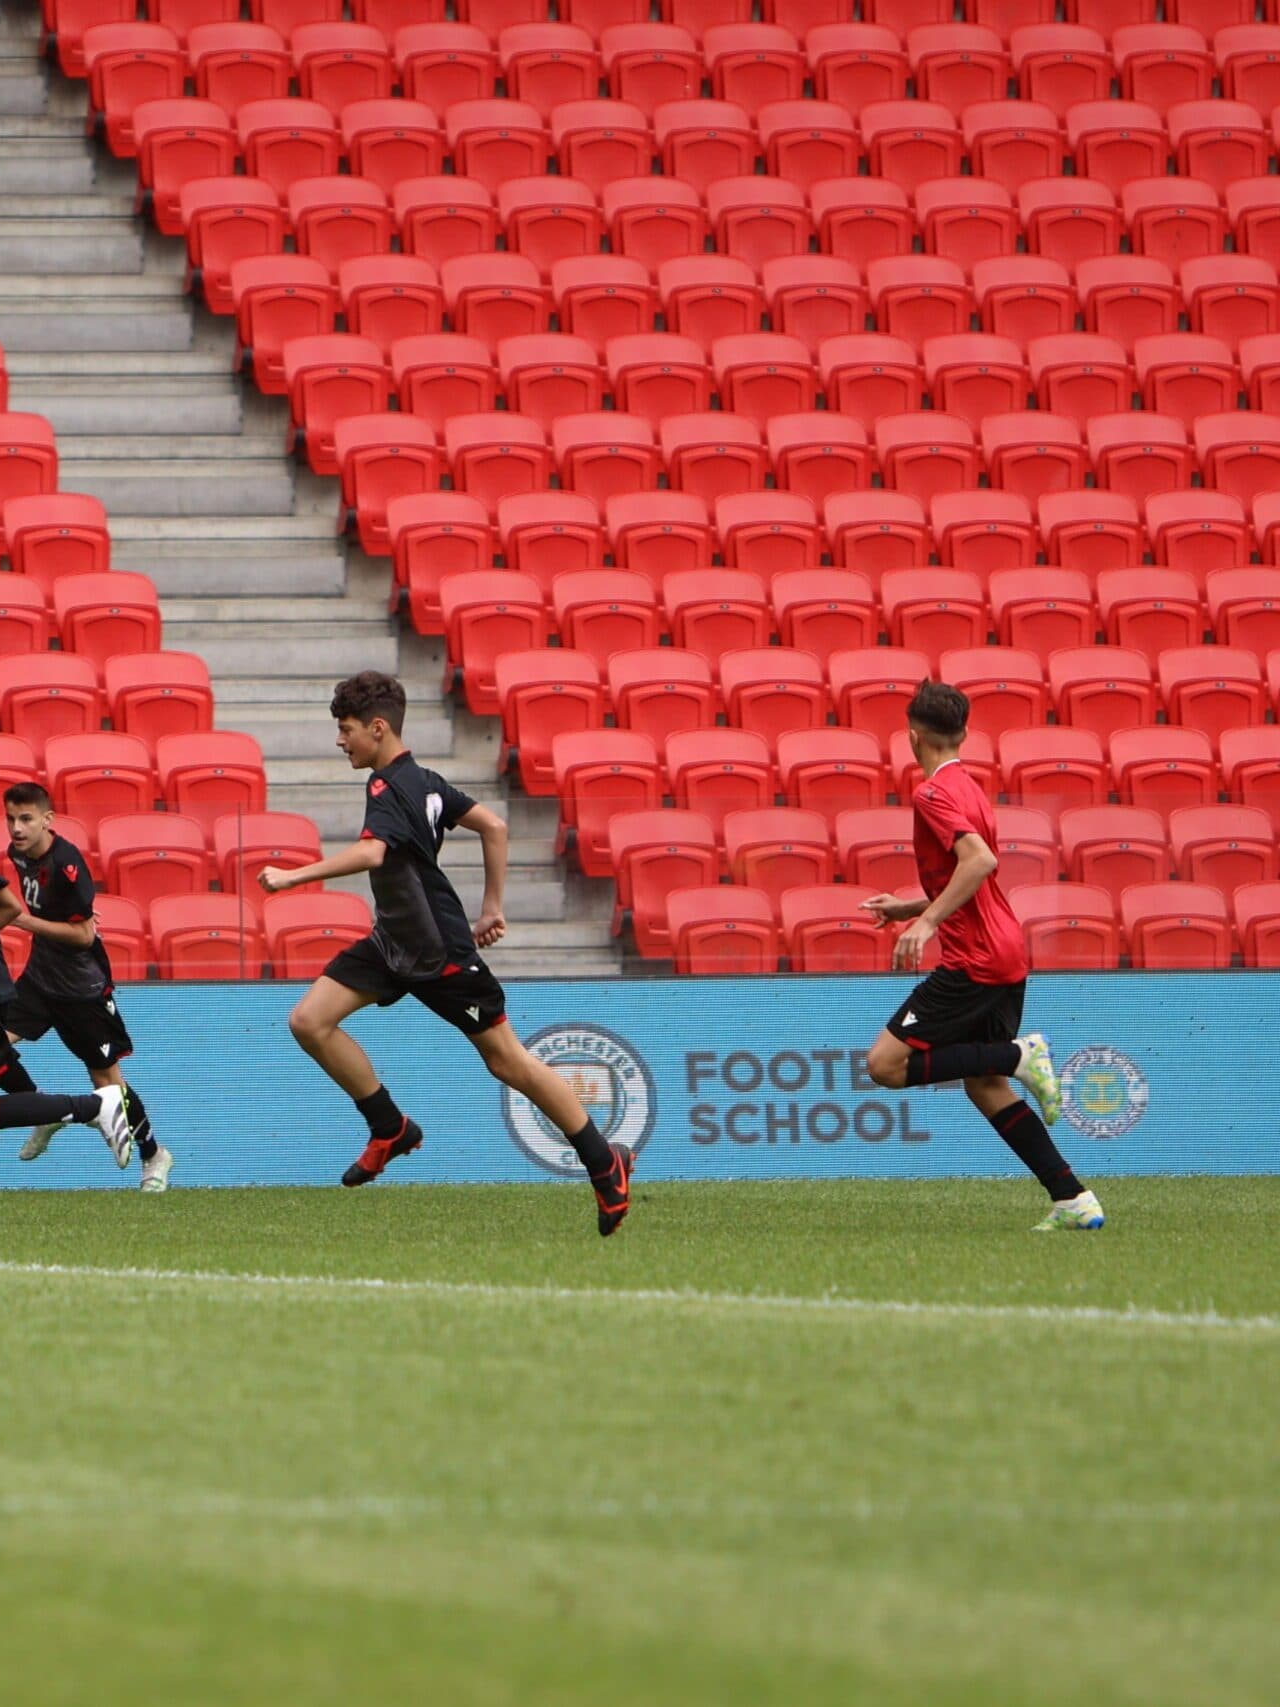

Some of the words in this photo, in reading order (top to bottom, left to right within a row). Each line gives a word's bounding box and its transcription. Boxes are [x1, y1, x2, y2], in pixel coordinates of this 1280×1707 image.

[23, 875, 41, 909] 22
[684, 1048, 963, 1093] FOOTB
[689, 1099, 932, 1146] SCHOOL
